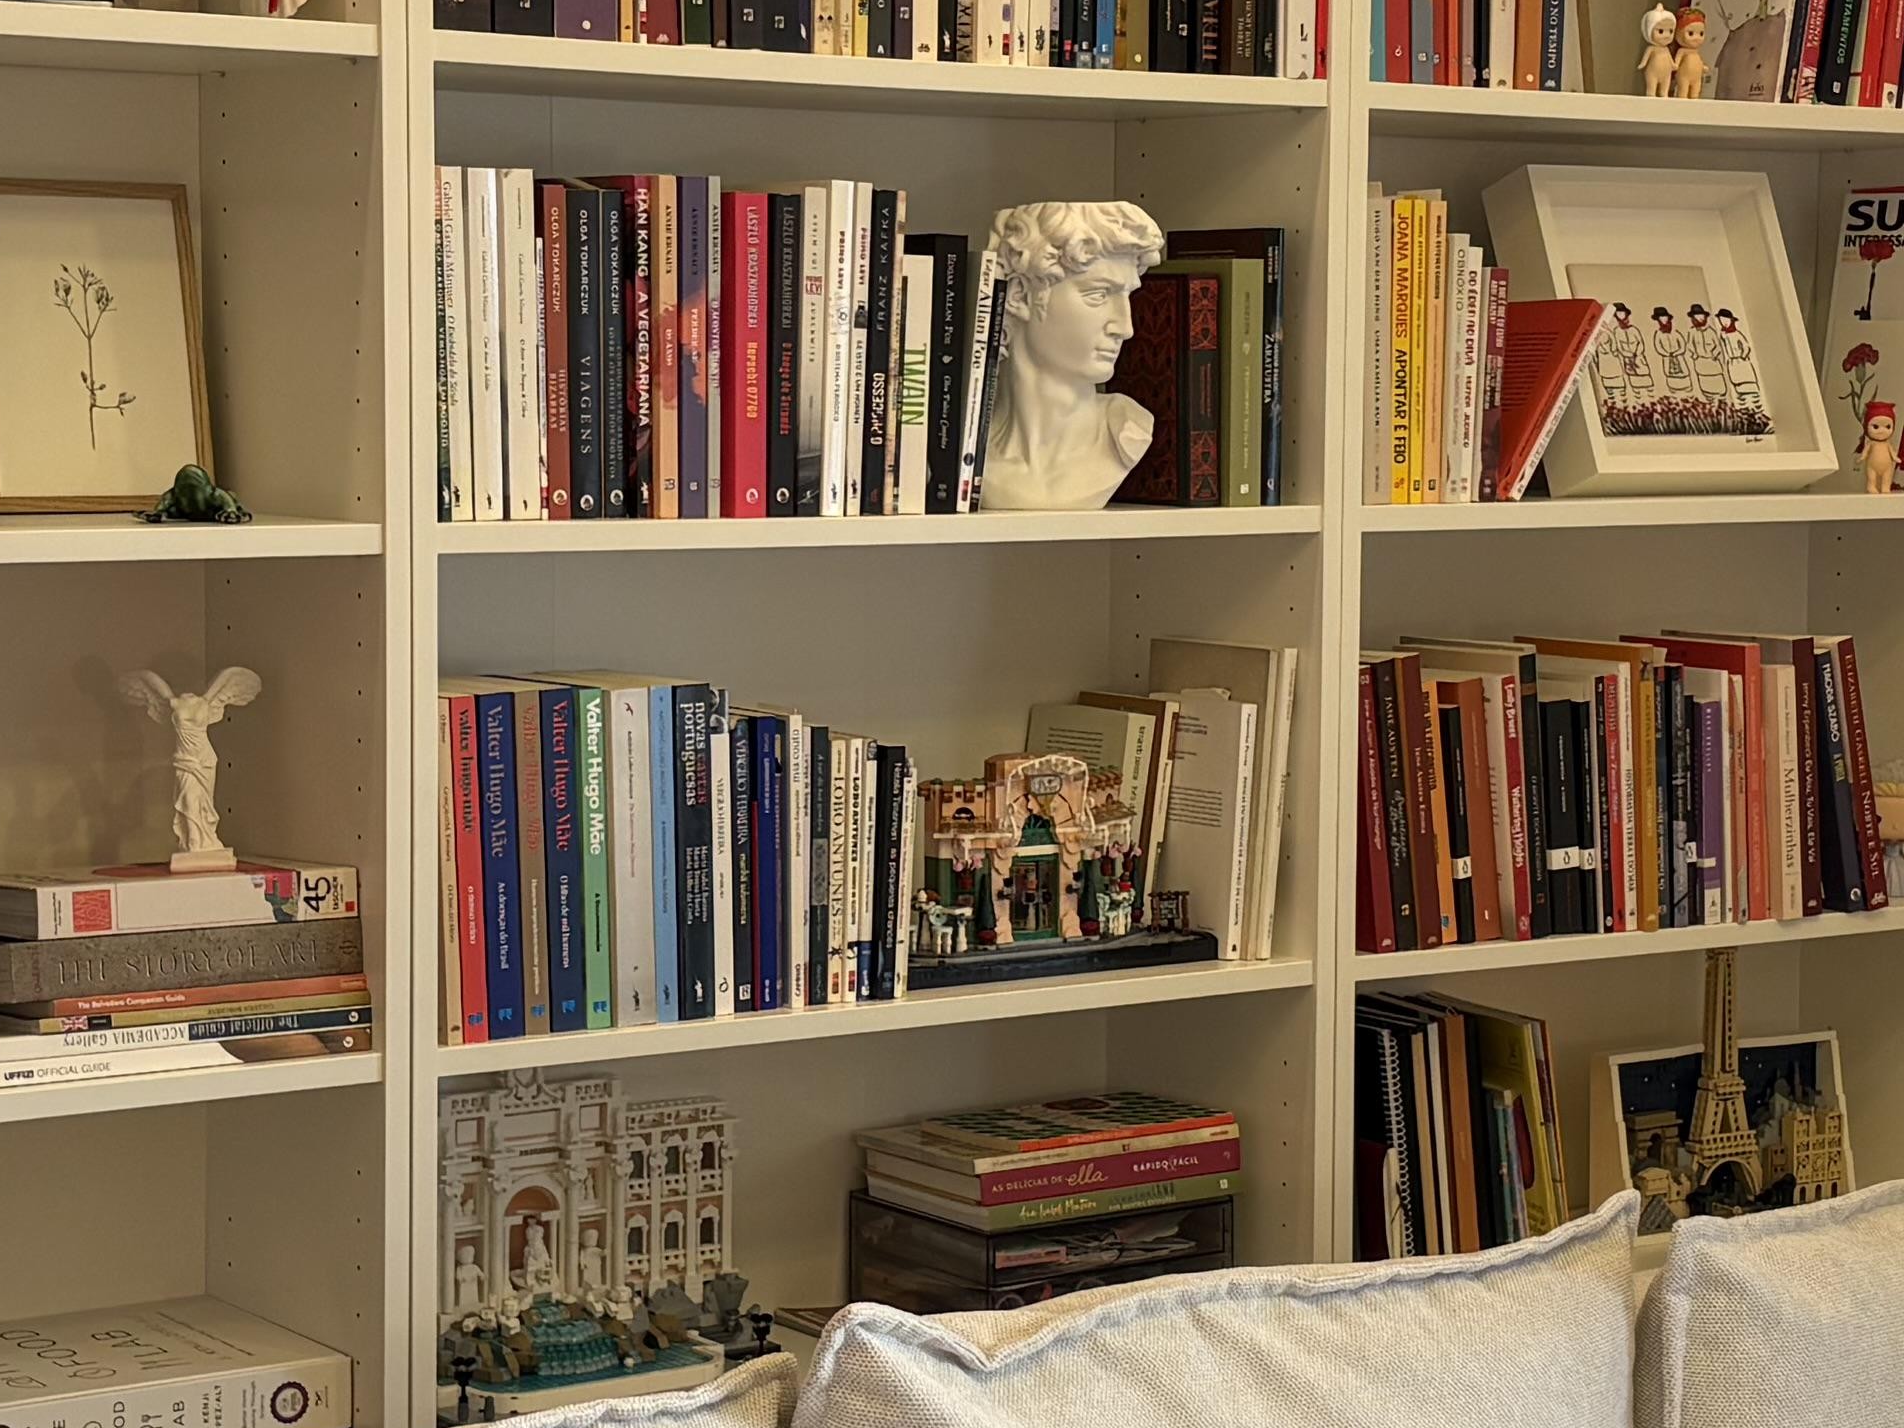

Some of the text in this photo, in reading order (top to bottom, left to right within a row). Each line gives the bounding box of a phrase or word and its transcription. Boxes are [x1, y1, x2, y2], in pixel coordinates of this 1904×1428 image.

[635, 187, 649, 225] HAN
[636, 228, 649, 280] KANG
[1397, 212, 1409, 264] JOANA
[1396, 269, 1409, 338] MARQUES
[636, 310, 651, 427] VEGETARIANA
[902, 343, 928, 426] TWAIN
[1394, 349, 1408, 419] APONTAR
[580, 355, 593, 454] VIAGENS
[1394, 436, 1406, 464] FEIO
[584, 698, 605, 856] Valter Hugo Mãe
[1783, 767, 1796, 869] Mulherzinhas
[126, 952, 212, 978] STORY
[225, 944, 261, 967] OF
[269, 939, 319, 966] ART
[37, 1064, 80, 1079] OFFICIAL
[82, 1061, 111, 1075] GUIDE
[991, 1164, 1109, 1194] AS DELÍCIAS DE ella
